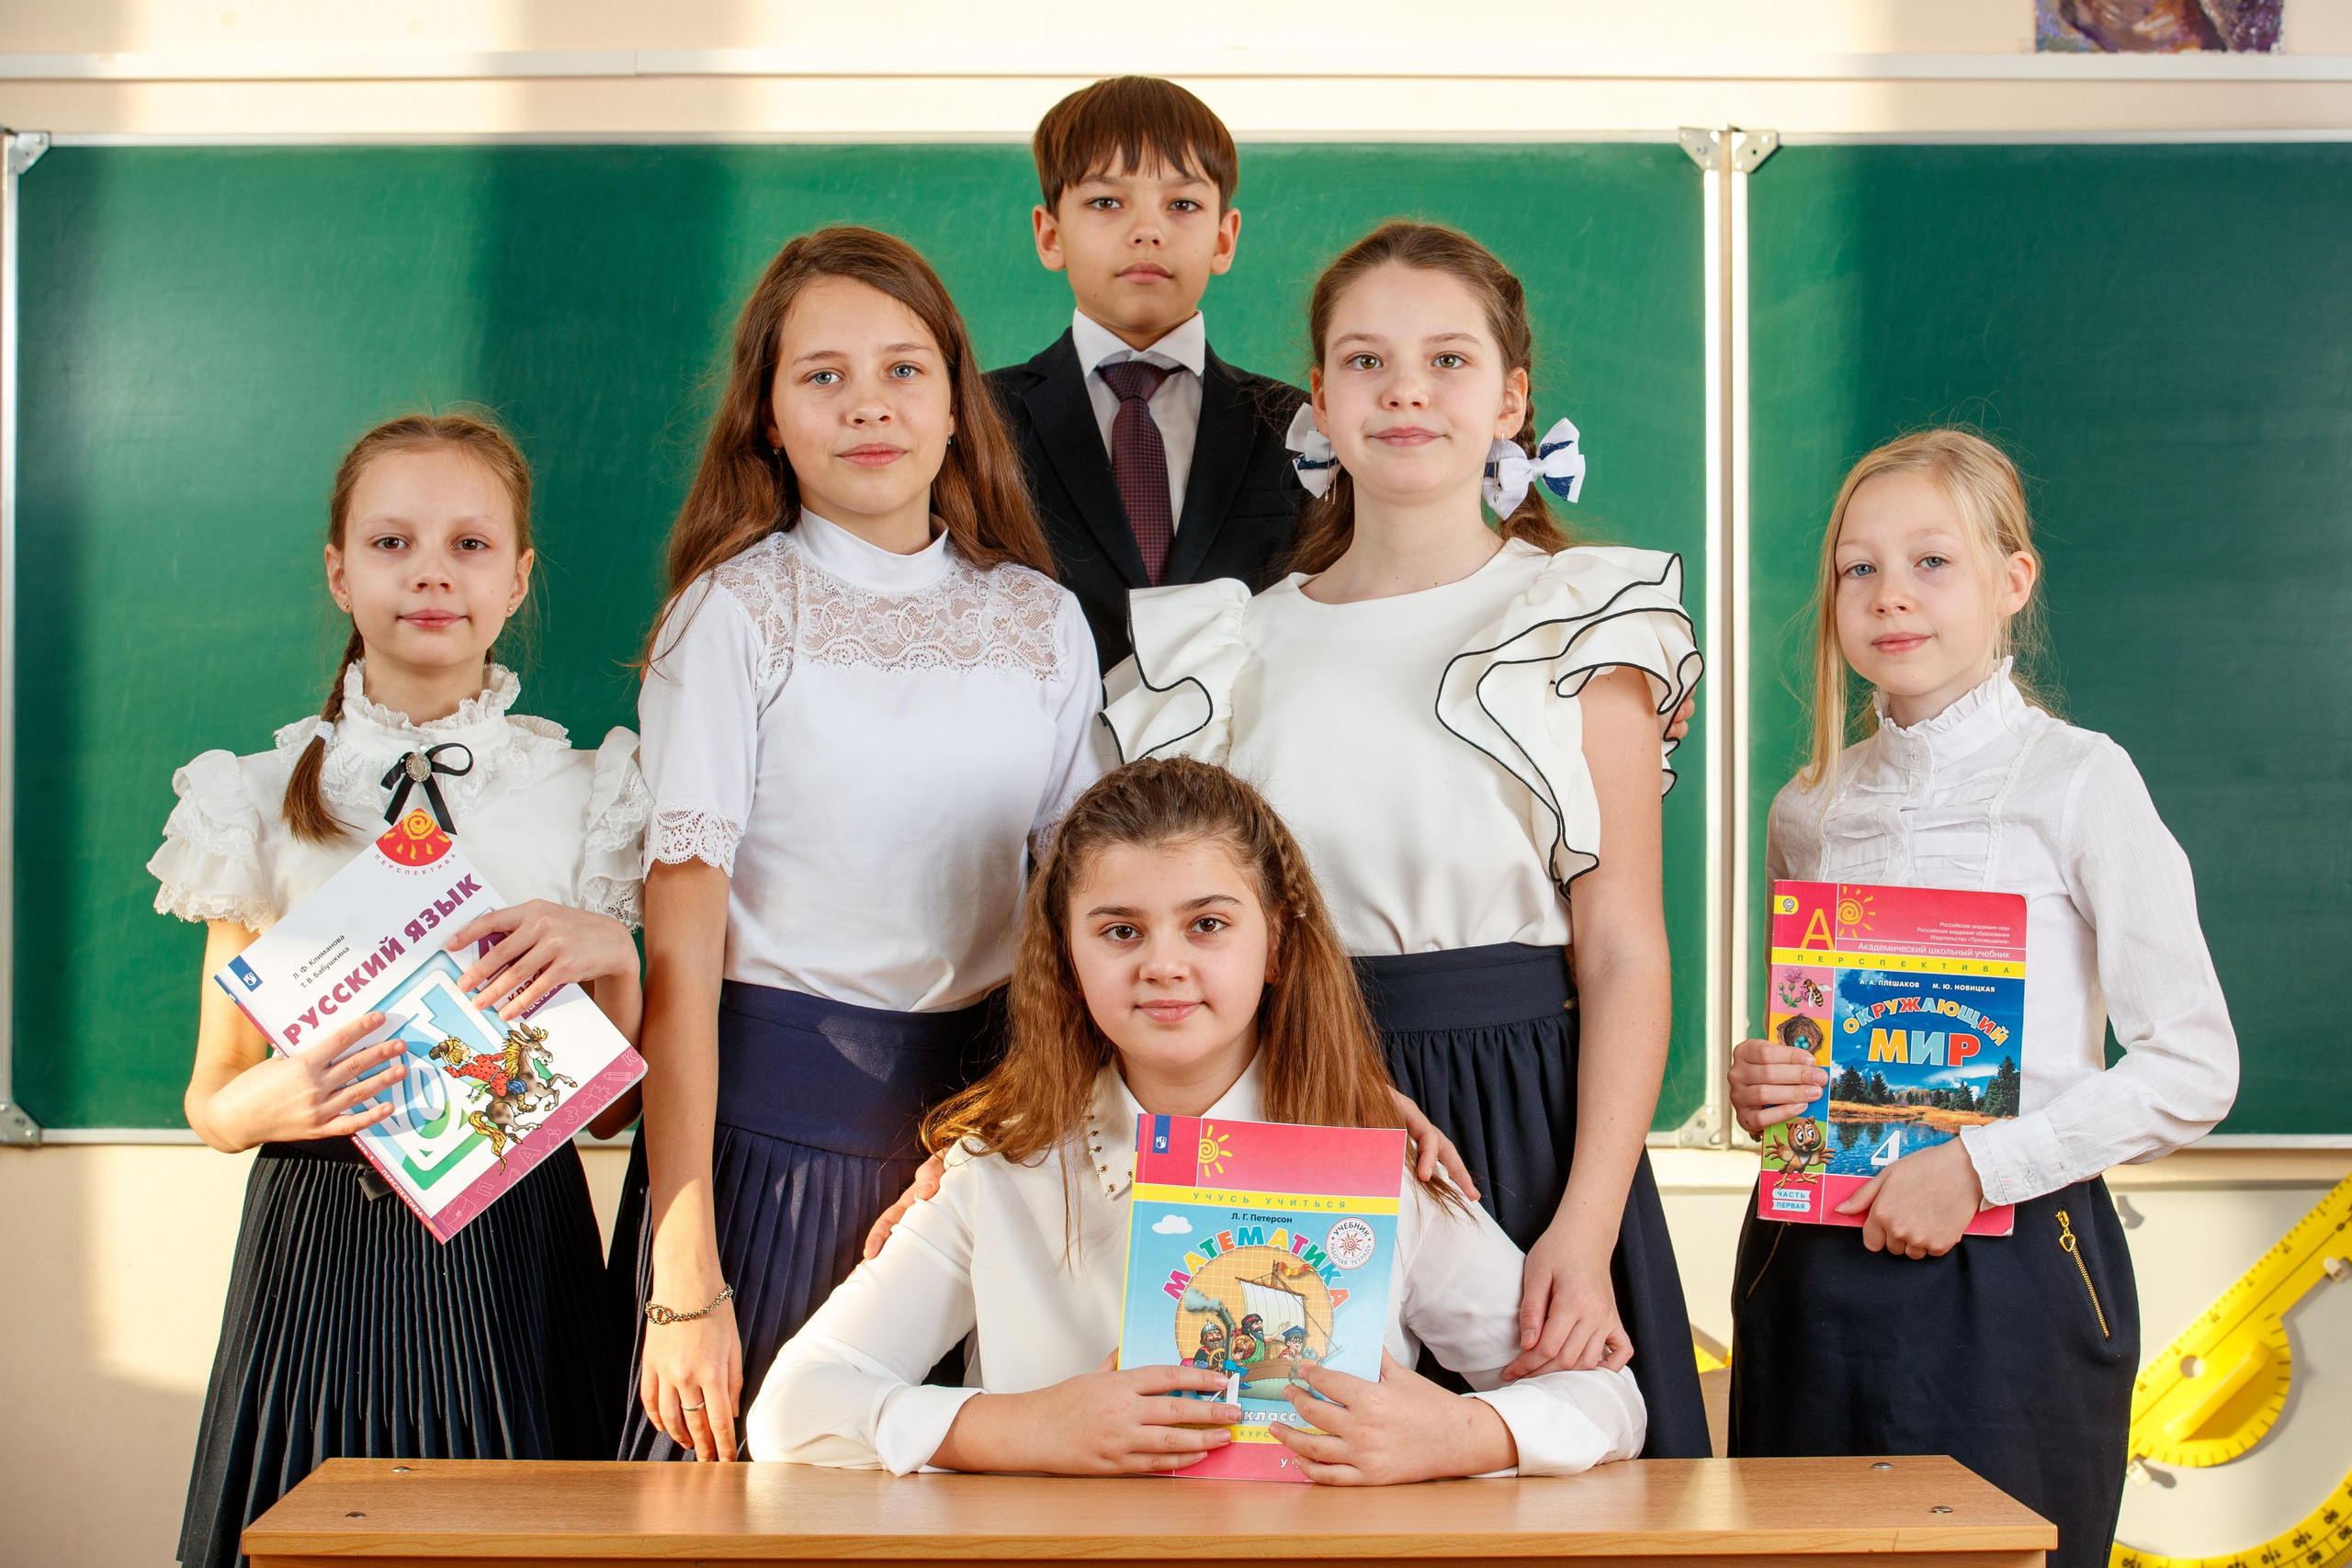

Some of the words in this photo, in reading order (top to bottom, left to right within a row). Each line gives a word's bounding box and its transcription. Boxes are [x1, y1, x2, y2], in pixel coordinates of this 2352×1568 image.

[374, 852, 457, 876] ПЕРСПЕКТИВА
[1939, 921, 1971, 930] Российская
[1929, 934, 1967, 942] Издательство
[300, 965, 311, 974] Ф.
[308, 934, 345, 966] Климанова
[1858, 942, 1927, 953] Академический
[1928, 946, 1974, 956] школьный
[1974, 949, 2010, 959] учебник
[282, 935, 406, 1046] РУССКИЙ
[404, 873, 483, 944] ЯЗЫК
[306, 976, 315, 985] В.
[312, 946, 350, 979] Бабушкина
[1797, 954, 2010, 974] ПЕРСПЕКТИВА
[1878, 979, 1920, 988] ПЛЕШАКОВ
[1954, 985, 1996, 993] НОВИЦКАЯ
[1843, 996, 2010, 1047] ОКРУЖАЮЩИЙ
[1867, 1028, 1982, 1067] МИР
[1871, 1130, 1901, 1167] 4
[381, 1169, 424, 1218] ПЕРСПЕКТИВА
[1193, 1192, 1250, 1203] УЧУСЬ
[1266, 1197, 1346, 1209] УЧИТЬСЯ
[1777, 1190, 1805, 1199] ЧАСТЬ
[1776, 1200, 1805, 1210] ПЕРВАЯ
[1231, 1213, 1241, 1221] Л.
[1242, 1213, 1250, 1222] Г.
[1250, 1214, 1293, 1224] Петерсон
[1333, 1222, 1371, 1237] УЧЕБНИК
[1330, 1243, 1349, 1266] РАБОЧАЯ
[1351, 1244, 1372, 1266] ТЕТРАДЬ
[1162, 1225, 1351, 1310] МАТЕМАТИКА
[1243, 1410, 1297, 1423] класс
[1239, 1430, 1270, 1438] КУРС
